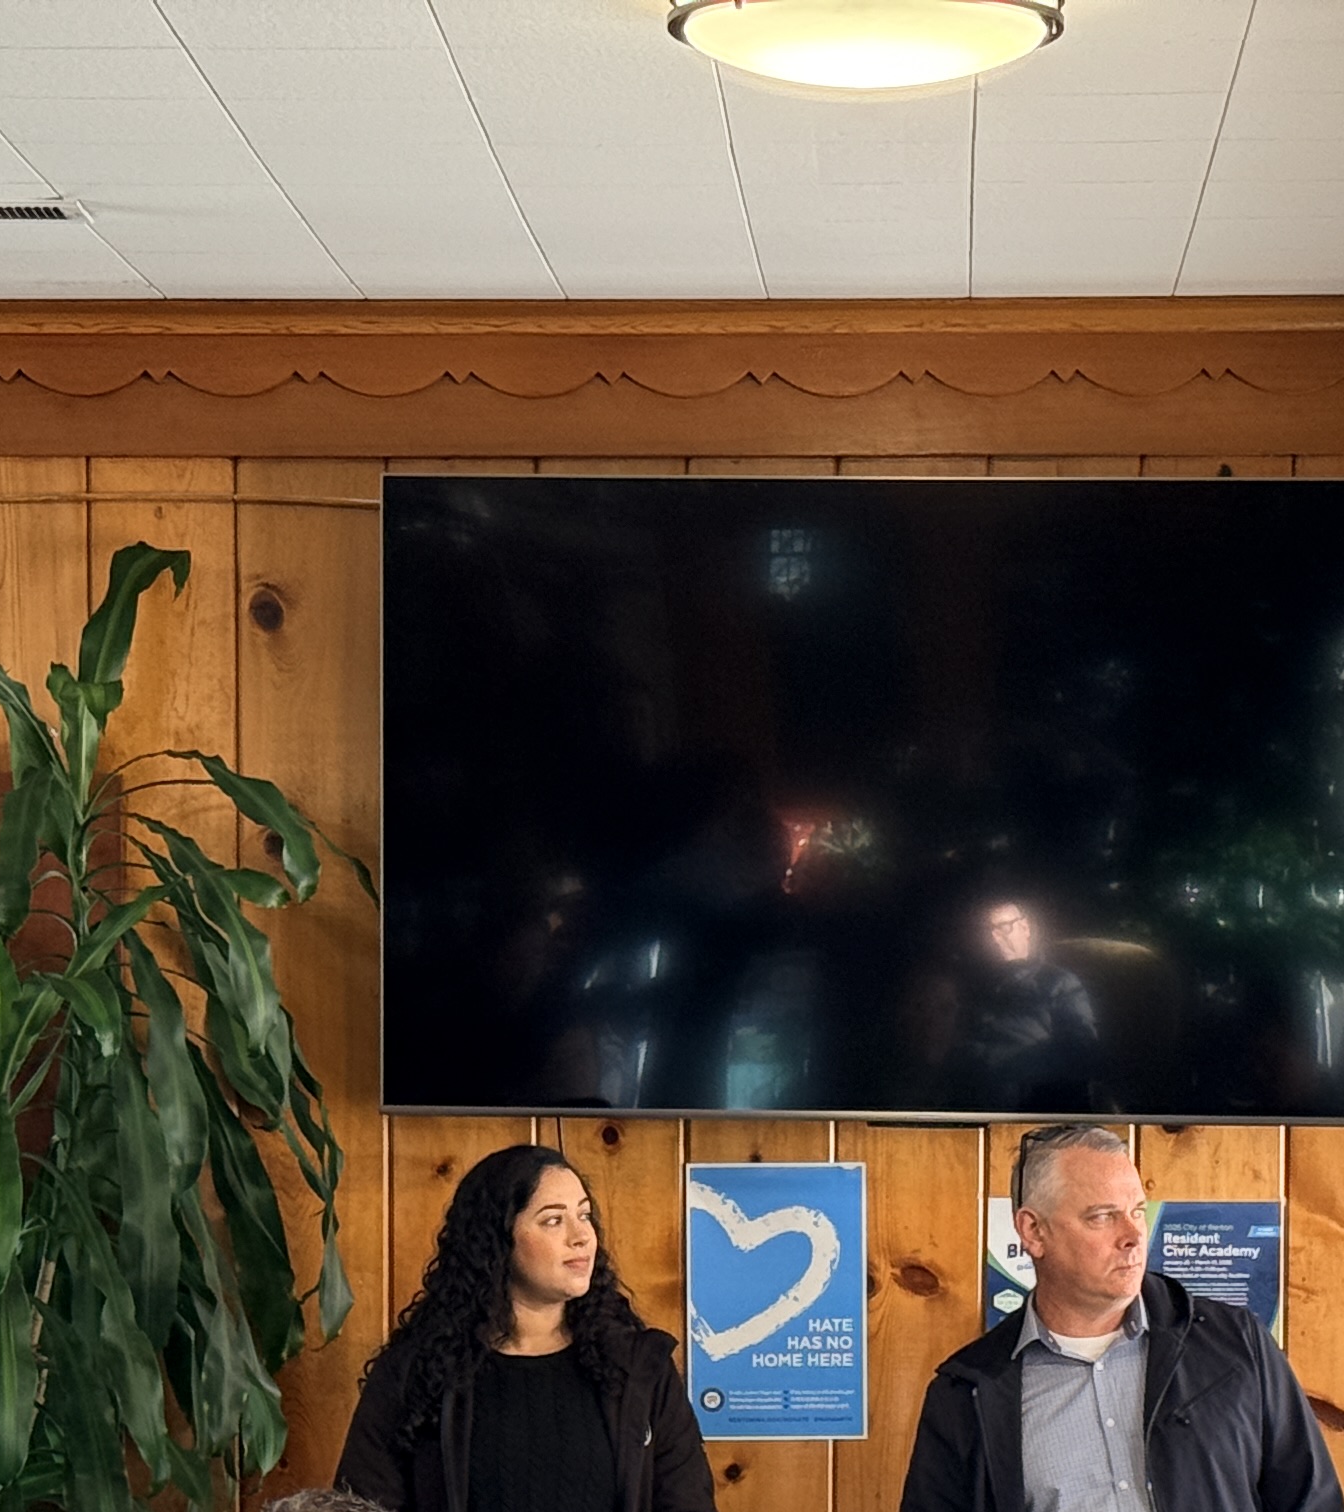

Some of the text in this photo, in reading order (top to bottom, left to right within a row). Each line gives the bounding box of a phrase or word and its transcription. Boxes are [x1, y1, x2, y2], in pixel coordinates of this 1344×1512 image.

[1163, 1232, 1220, 1245] Resident
[1163, 1244, 1260, 1260] Civic Academy
[809, 1319, 853, 1332] HATE
[788, 1337, 853, 1350] HAS NO
[753, 1354, 853, 1368] HOME HERE
